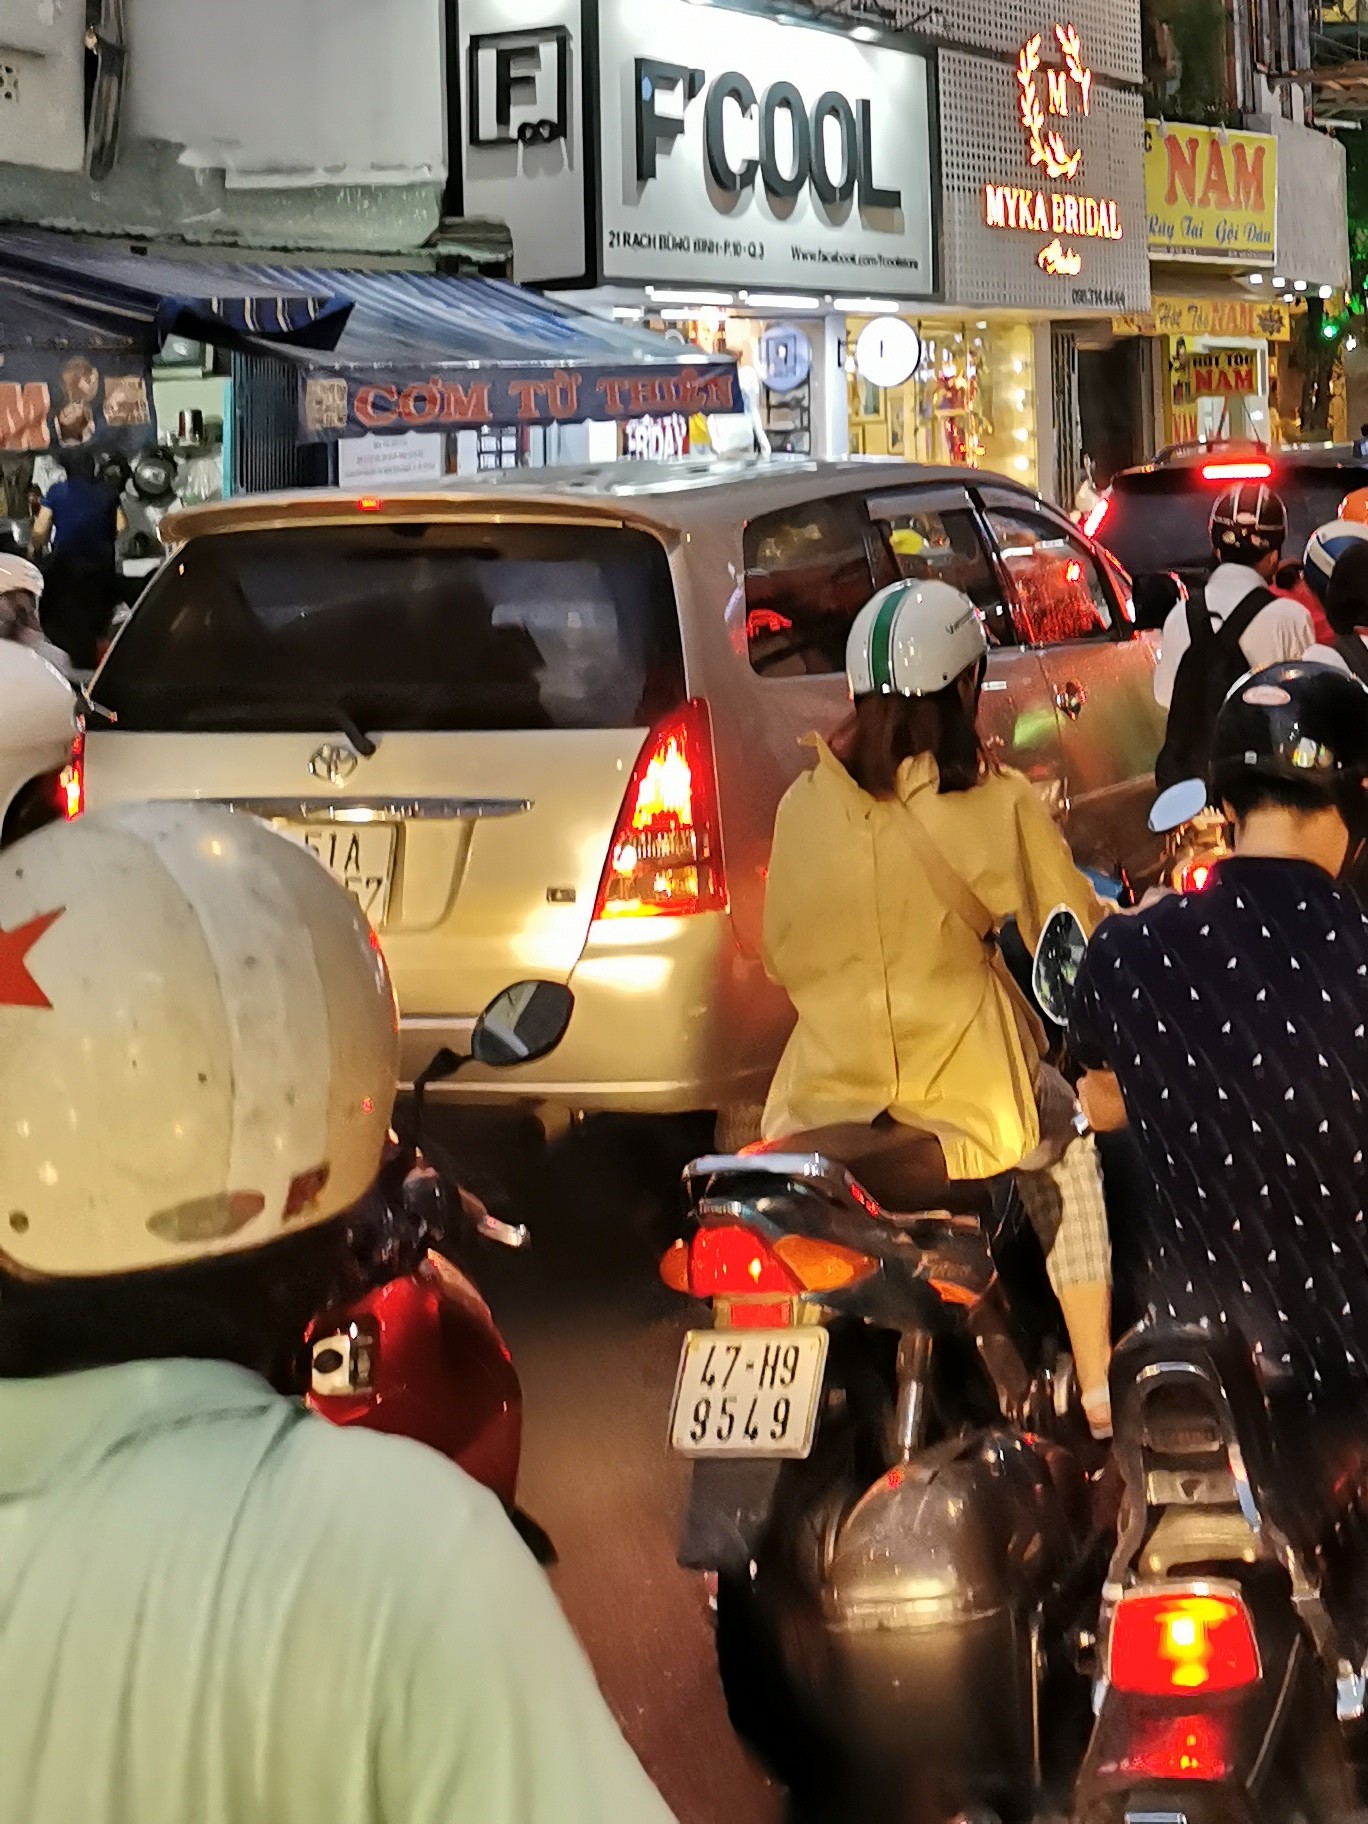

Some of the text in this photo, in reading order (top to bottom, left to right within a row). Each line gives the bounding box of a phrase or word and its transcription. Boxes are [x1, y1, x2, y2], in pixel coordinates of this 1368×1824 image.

[1163, 134, 1266, 213] NAM
[985, 182, 1124, 240] MYKA BRIDAL
[608, 230, 620, 248] 21
[353, 376, 494, 427] CƠM
[1194, 368, 1253, 392] NAM
[699, 1344, 801, 1392] 47-H9
[690, 1396, 792, 1443] 9549
